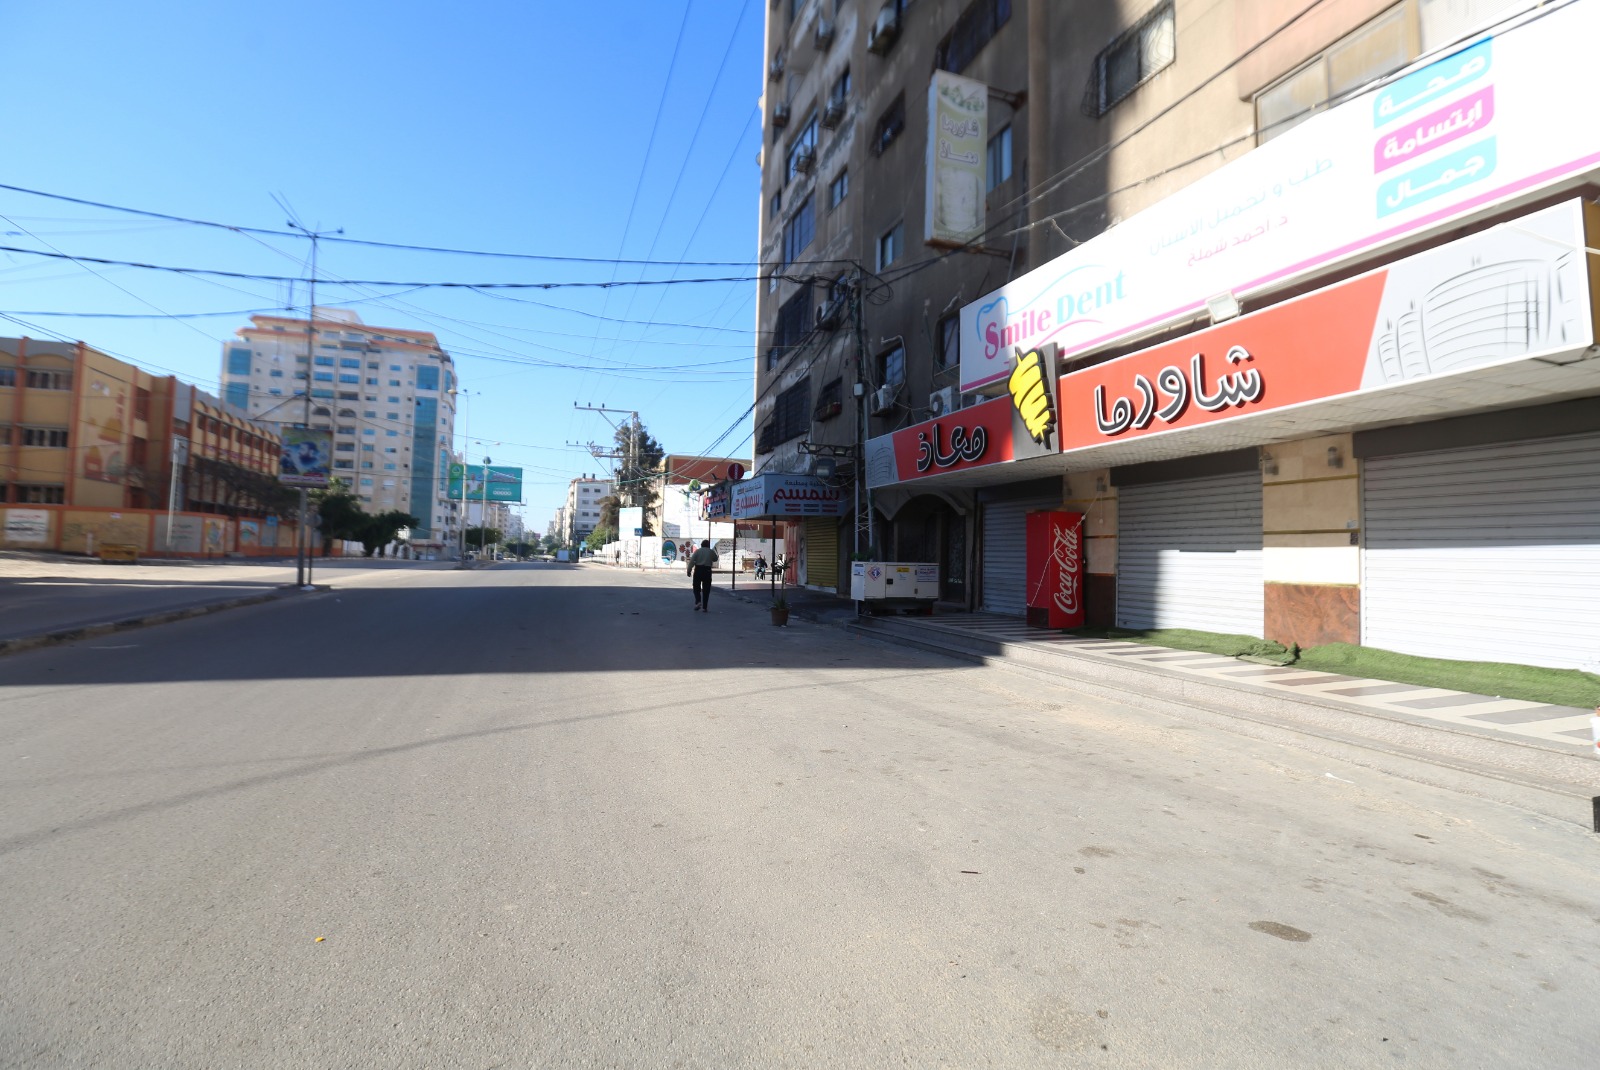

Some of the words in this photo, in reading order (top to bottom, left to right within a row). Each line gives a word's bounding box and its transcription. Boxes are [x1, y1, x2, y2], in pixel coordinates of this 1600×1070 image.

[1378, 55, 1487, 118] صحة
[939, 139, 980, 165] معاذ
[941, 115, 980, 138] شاورما
[1383, 99, 1483, 160] ابتسامة
[1272, 183, 1283, 198] و
[1288, 158, 1334, 187] طب
[1385, 155, 1486, 208] جمال
[984, 309, 1051, 360] Smile
[1056, 269, 1128, 325] Dent
[1094, 345, 1263, 434] شاورما
[916, 423, 988, 472] معاذ
[773, 488, 839, 503] سمسم
[1053, 523, 1078, 614] Coca-Cola
